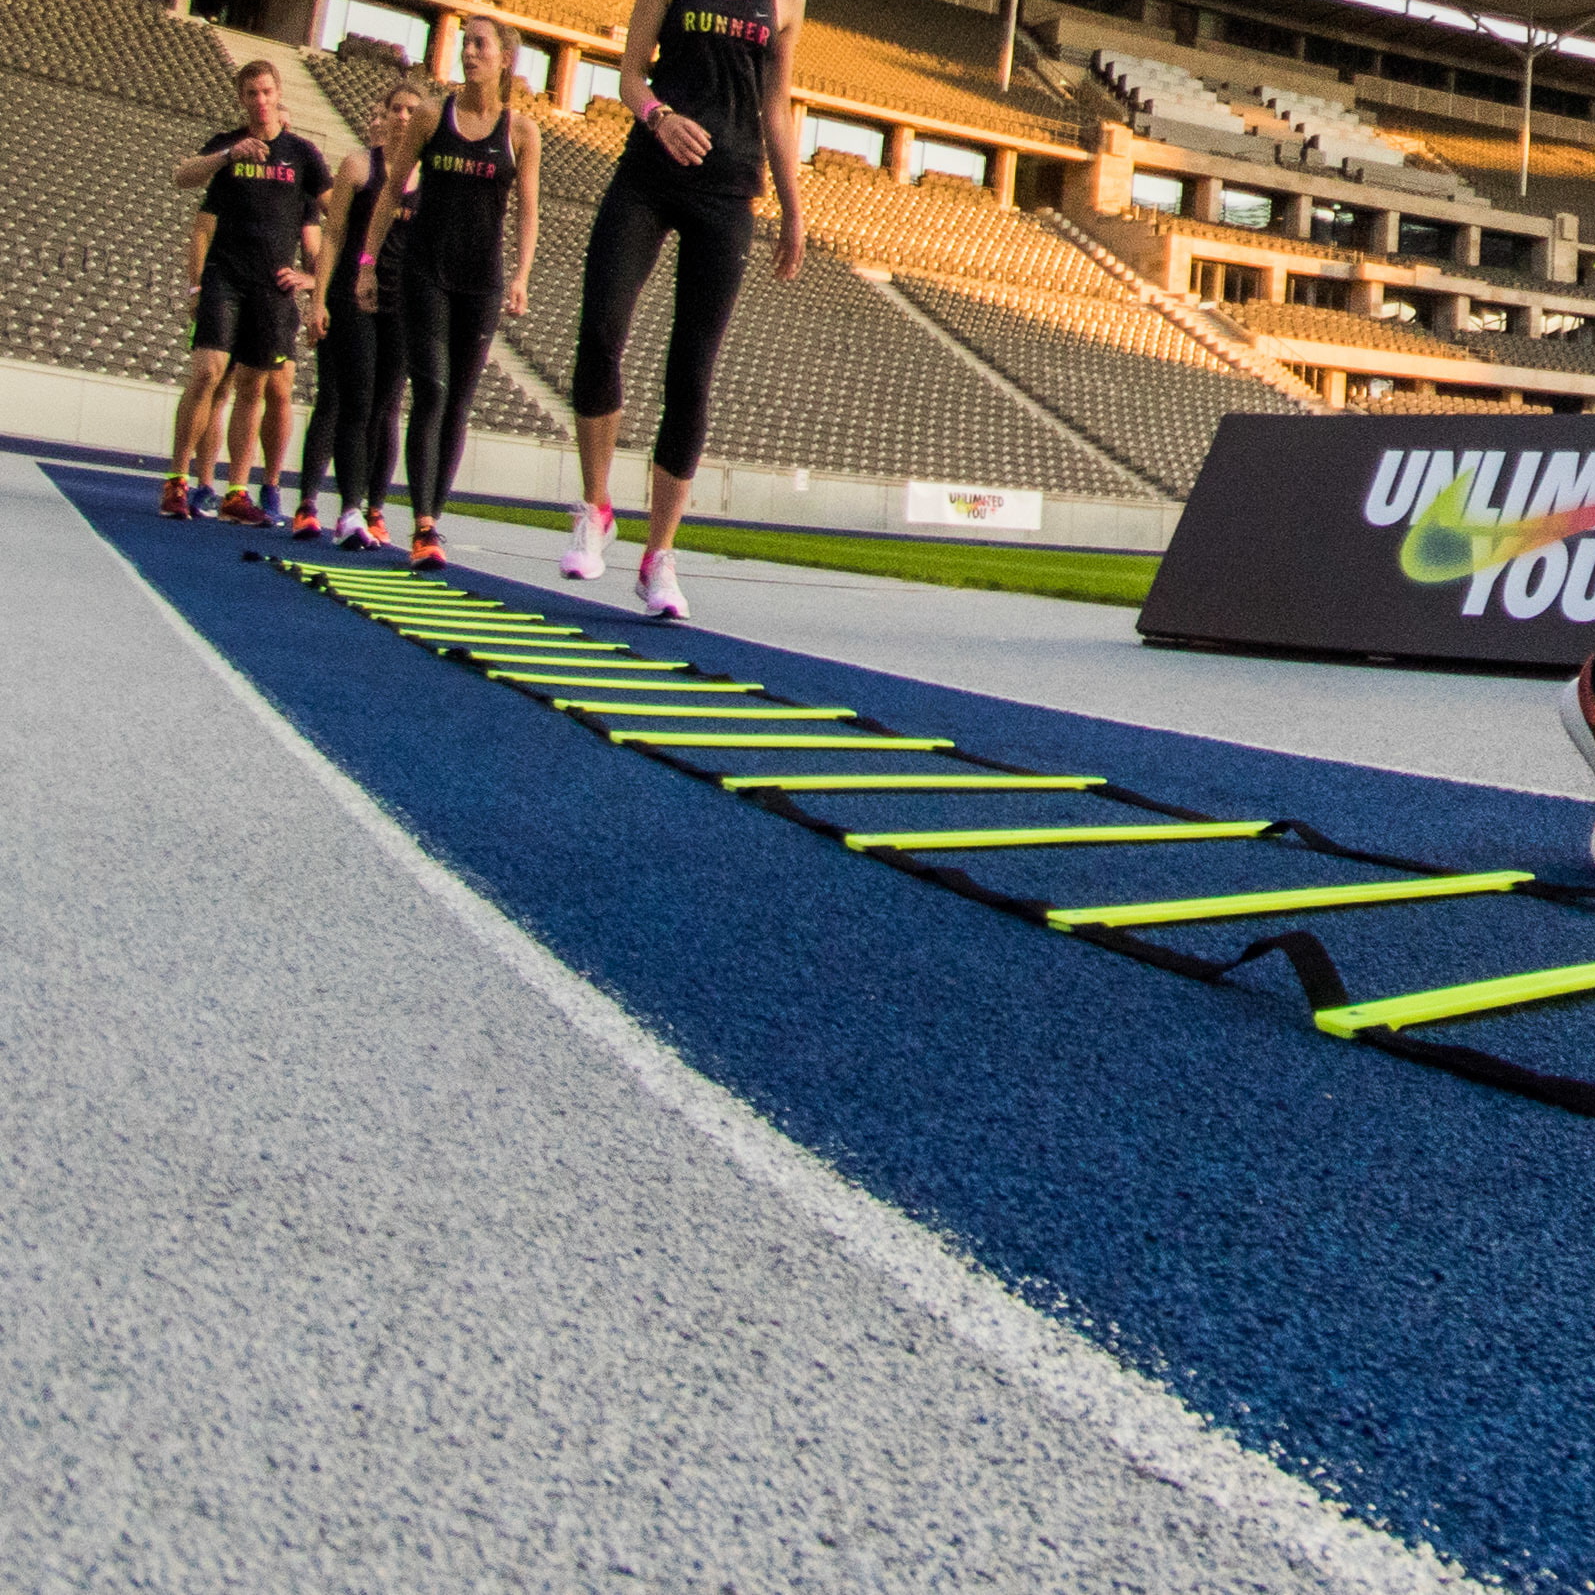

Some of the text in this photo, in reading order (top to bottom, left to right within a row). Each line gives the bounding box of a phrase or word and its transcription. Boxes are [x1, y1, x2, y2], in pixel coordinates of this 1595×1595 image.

[684, 11, 771, 47] RUNNER
[234, 162, 296, 183] RUNNER
[434, 155, 497, 179] RUNNER
[949, 492, 1005, 508] UNLIMITED
[965, 505, 987, 520] YOU
